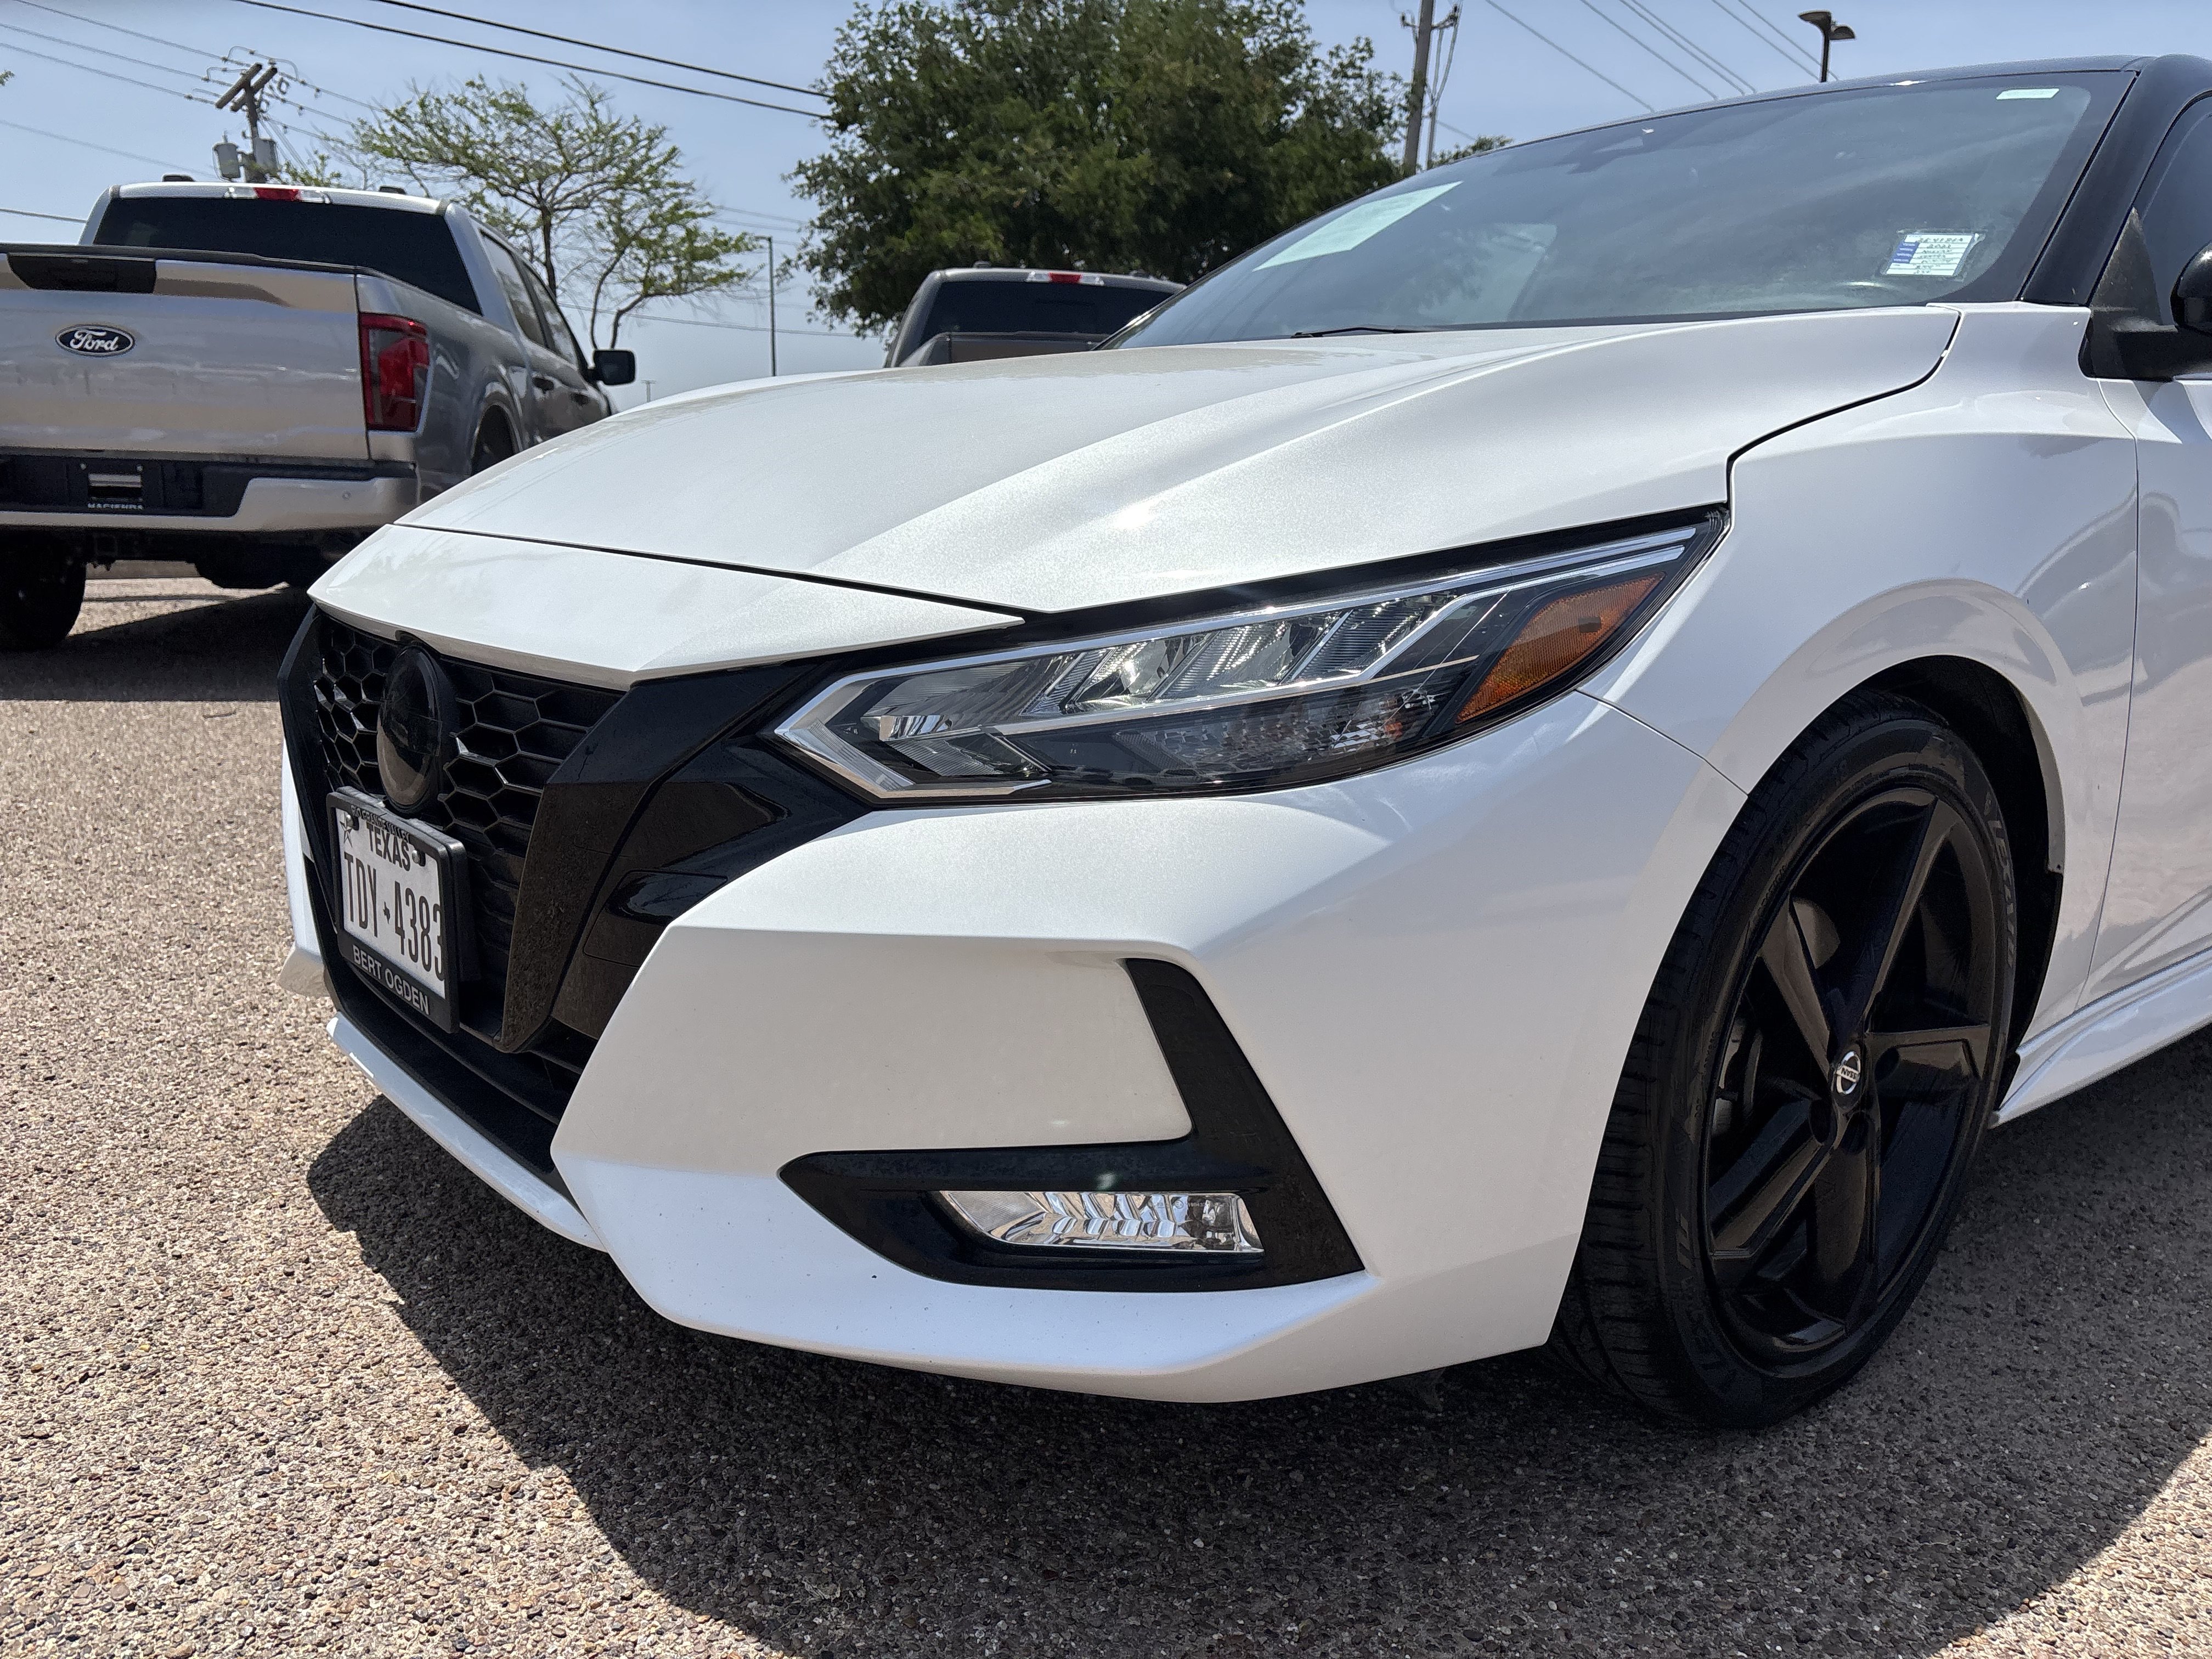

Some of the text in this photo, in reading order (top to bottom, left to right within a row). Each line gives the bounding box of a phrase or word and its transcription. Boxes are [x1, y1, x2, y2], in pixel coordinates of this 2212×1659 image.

[70, 329, 119, 351] Ford
[351, 805, 410, 843] RIO GRANDE VALLEY
[366, 822, 411, 871] TEXAS
[344, 851, 445, 981] TDY 4383
[353, 945, 430, 1015] BERT OGDEN
